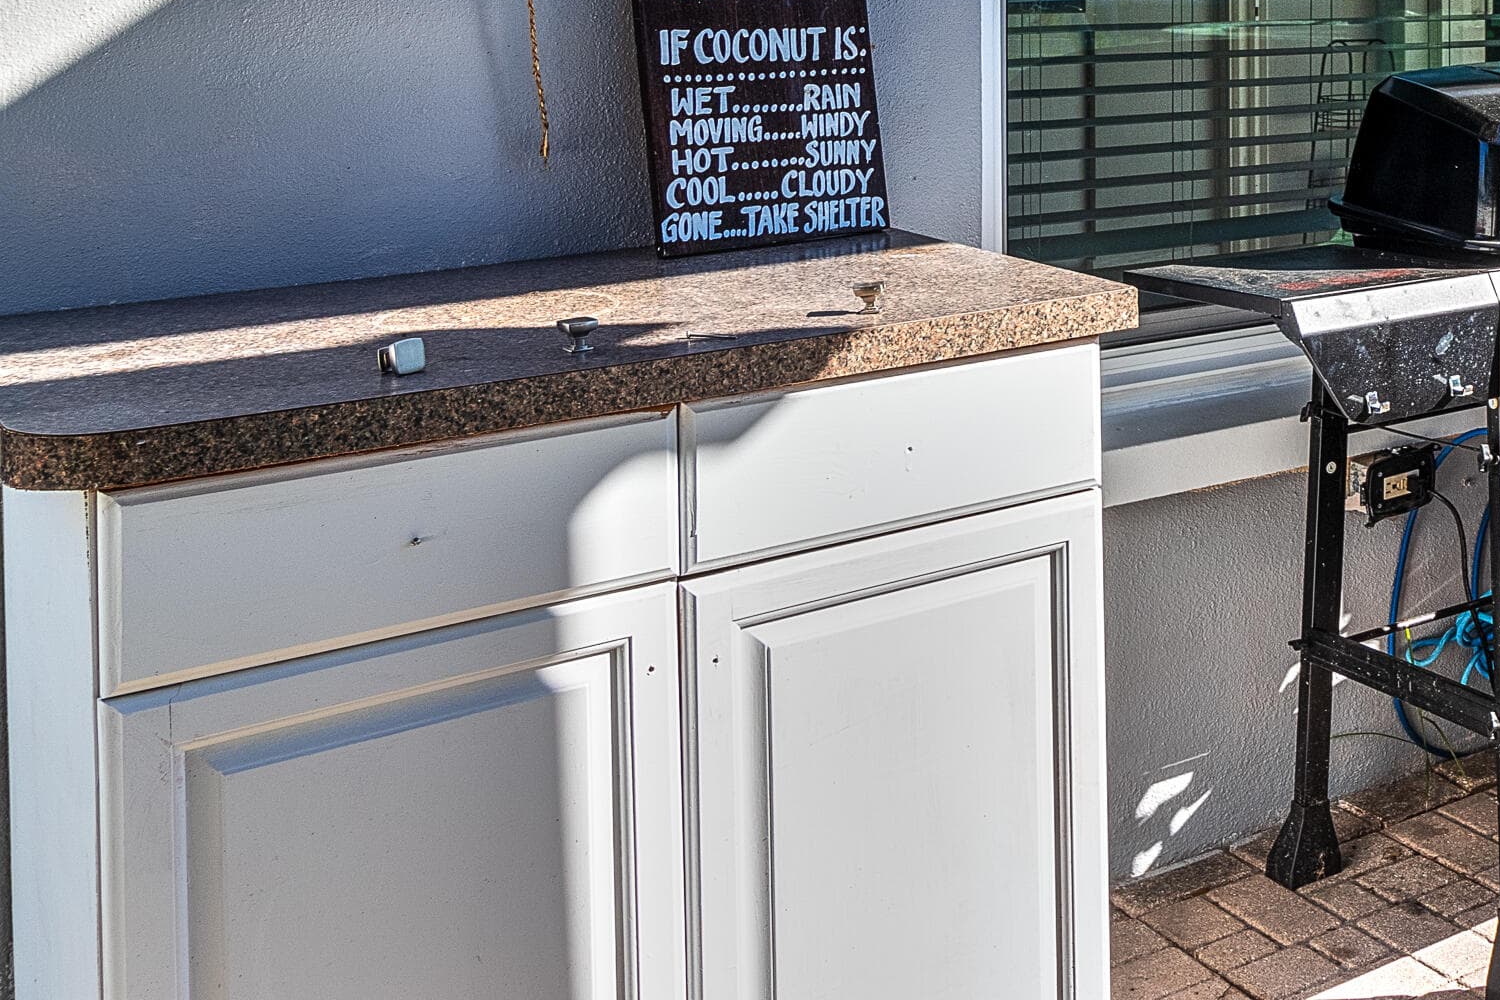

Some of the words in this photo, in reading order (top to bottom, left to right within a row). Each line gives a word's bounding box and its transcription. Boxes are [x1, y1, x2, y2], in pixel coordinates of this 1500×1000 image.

[659, 29, 690, 65] IF
[693, 27, 826, 64] COCONUT
[803, 82, 861, 111] RAIN
[801, 110, 871, 139] WINDY
[805, 139, 876, 168] SUNNY
[781, 168, 874, 198] CLOUDY
[740, 203, 799, 237] TAKE
[803, 196, 886, 233] SHELTER
